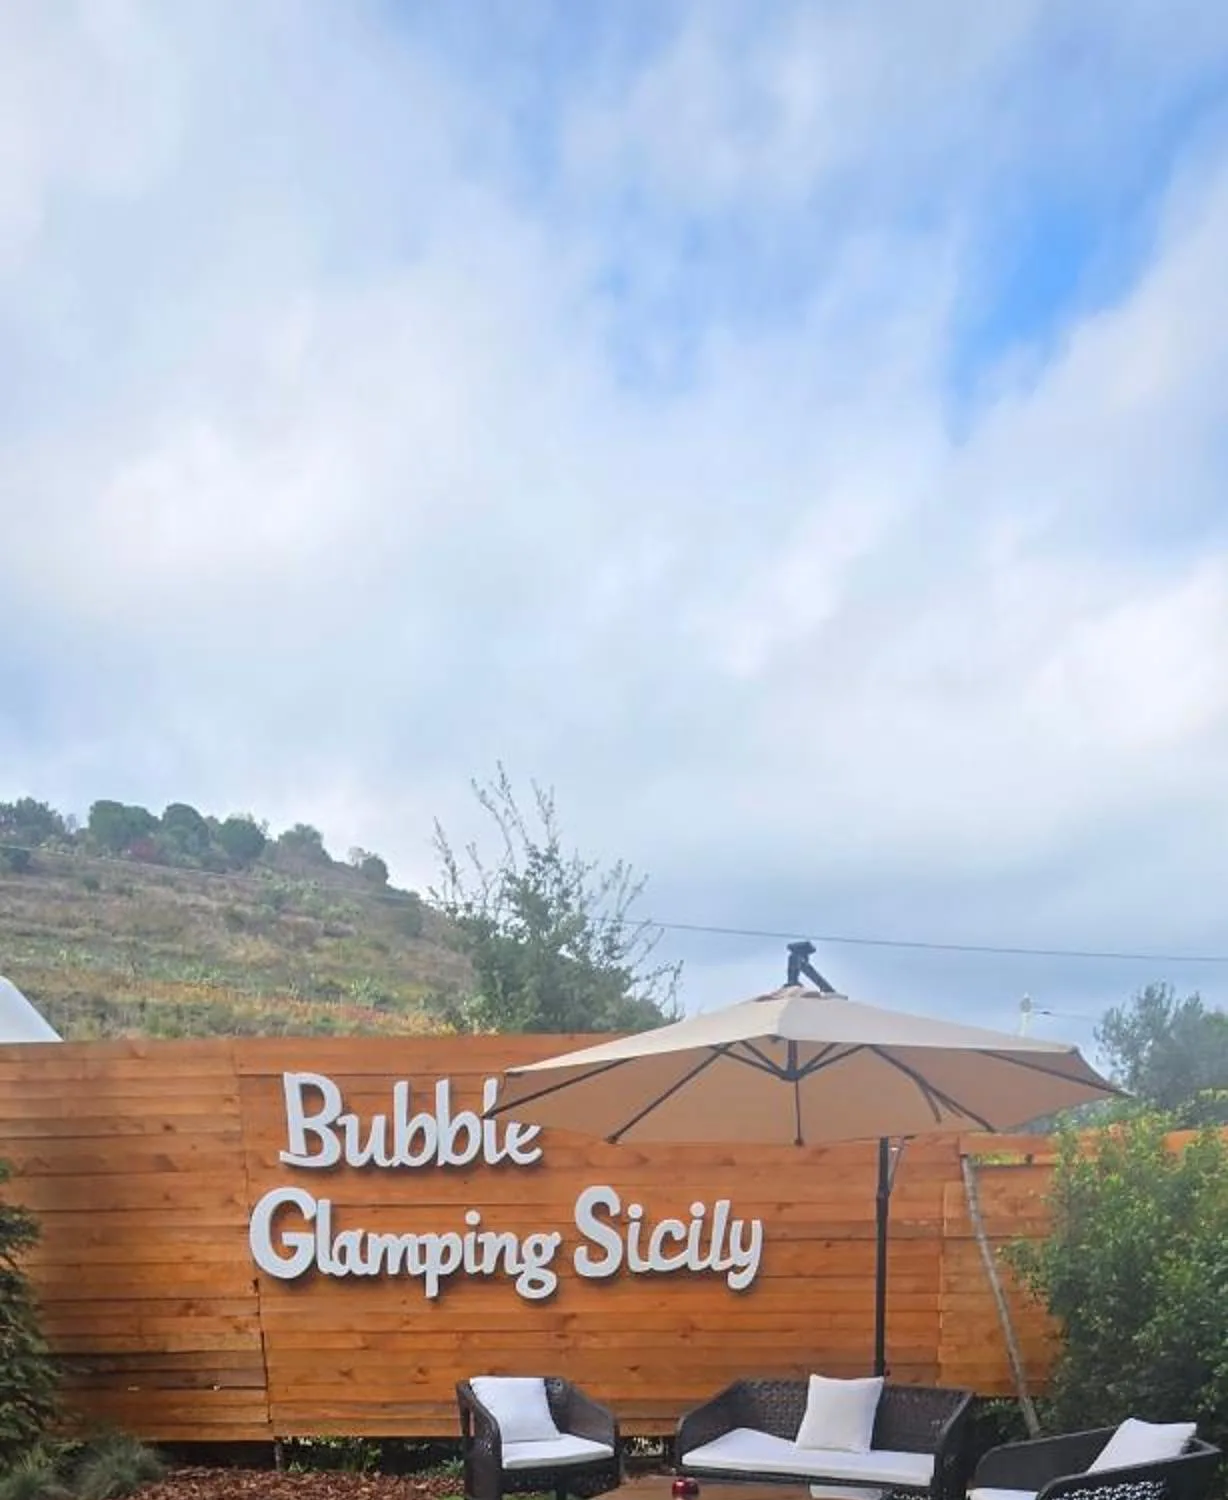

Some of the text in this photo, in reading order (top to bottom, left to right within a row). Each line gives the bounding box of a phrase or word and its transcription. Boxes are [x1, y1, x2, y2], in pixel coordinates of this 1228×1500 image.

[280, 1072, 543, 1168] Bubble
[249, 1185, 763, 1299] Glamping Sicily
